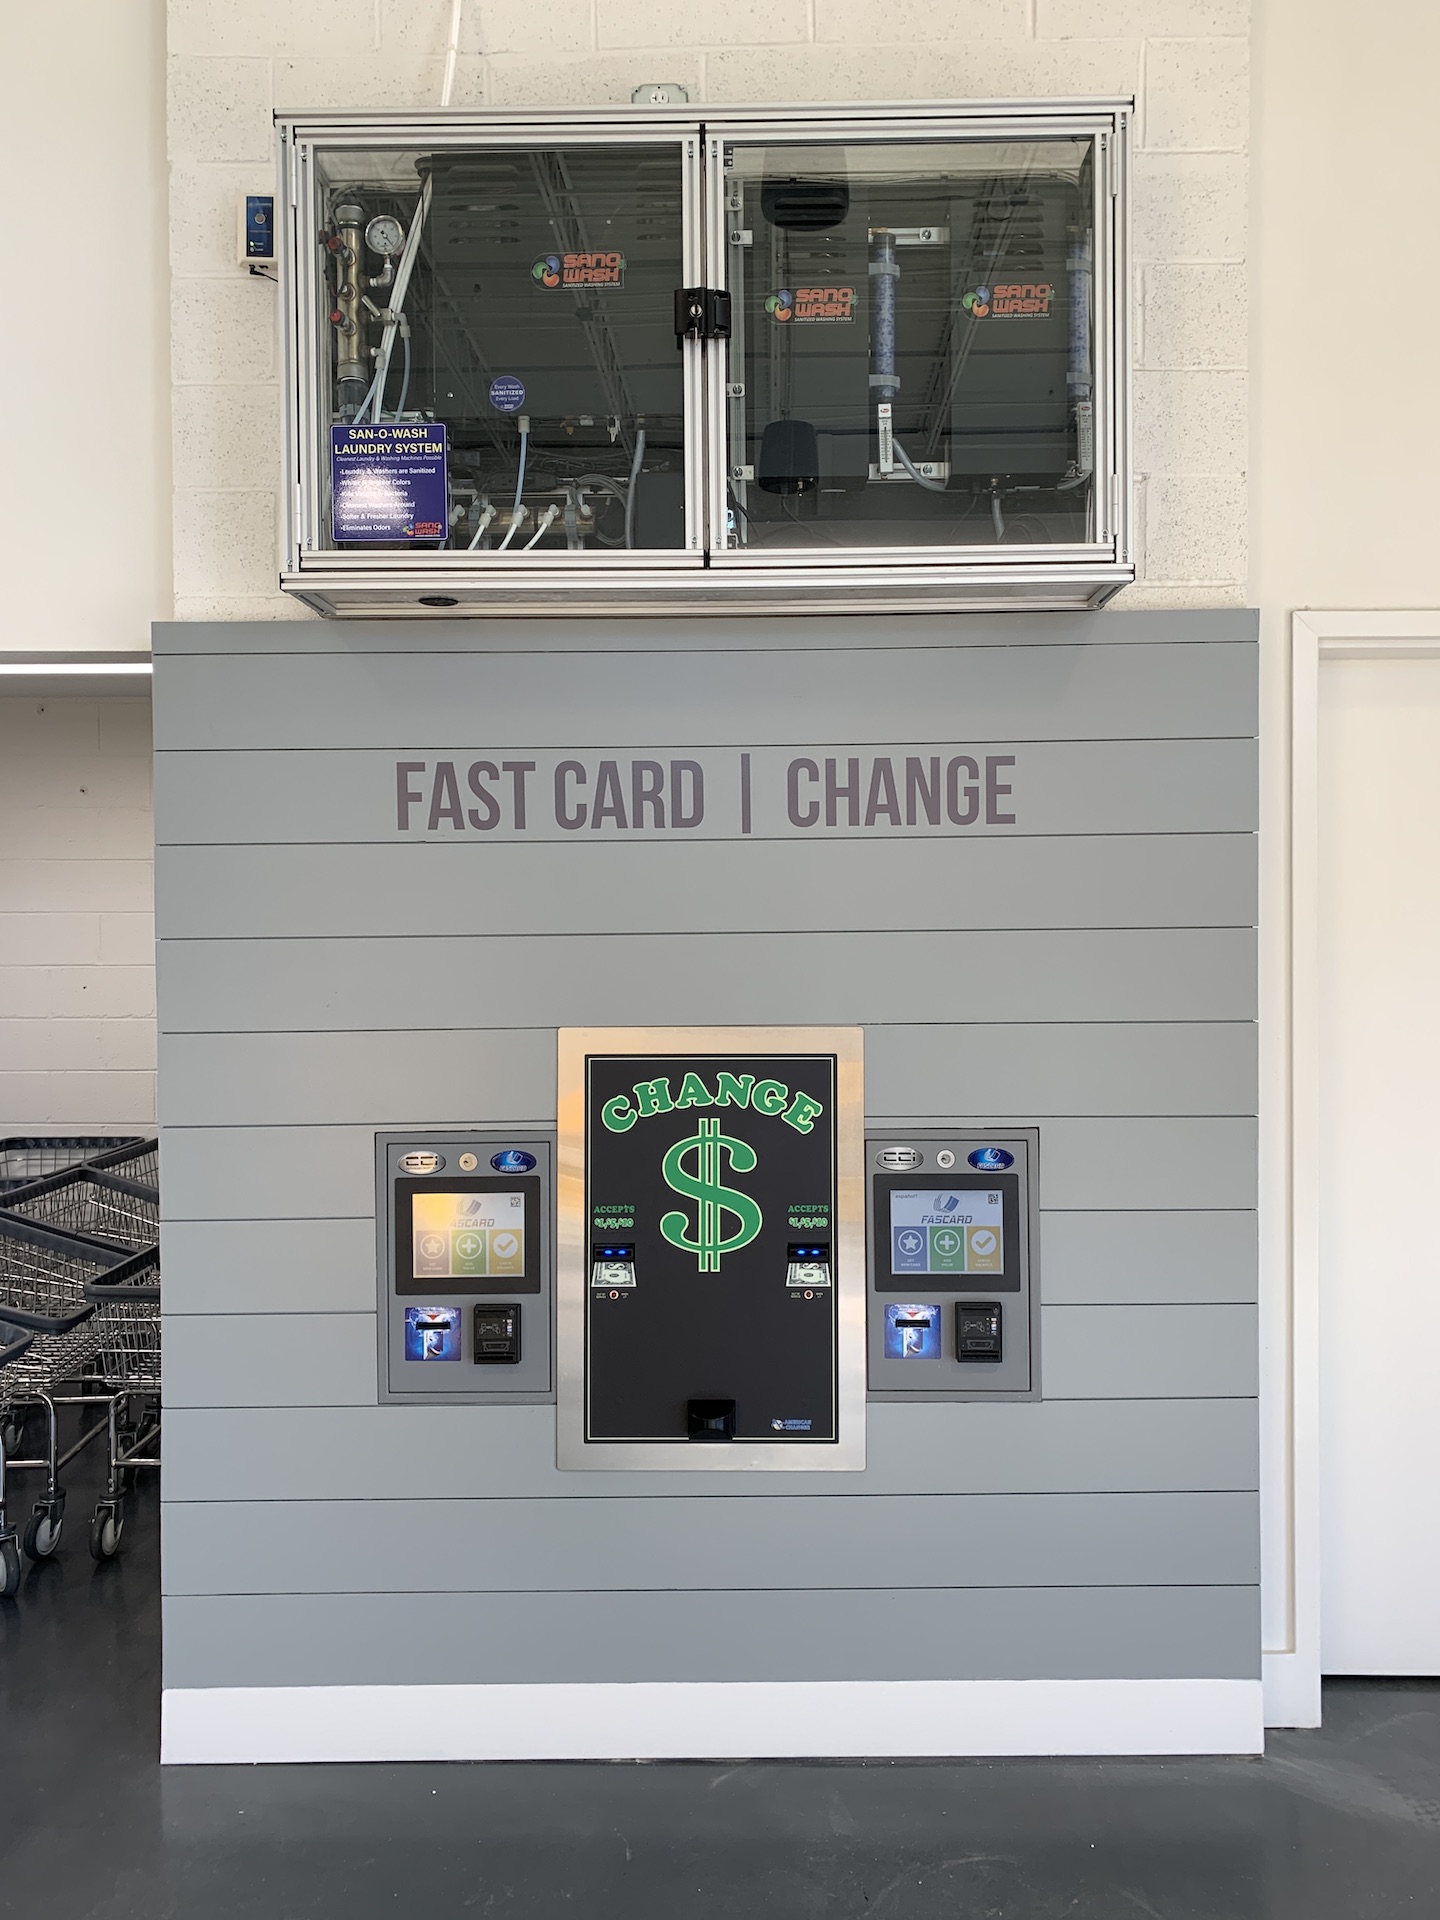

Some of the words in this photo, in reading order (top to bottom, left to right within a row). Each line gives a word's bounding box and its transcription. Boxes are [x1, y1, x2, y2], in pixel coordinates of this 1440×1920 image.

[563, 268, 619, 283] WASH
[795, 303, 851, 317] WASH
[993, 300, 1049, 314] WASH
[349, 428, 427, 439] SAN-O-WASH
[335, 443, 392, 454] LAUNDRY
[395, 442, 442, 453] SYSTEM
[409, 466, 436, 474] Sanitized
[373, 523, 391, 531] Odors
[396, 761, 536, 831] FAST
[554, 759, 704, 829] CARD
[786, 755, 1017, 828] CHANGE
[601, 1072, 823, 1134] CHANGE
[594, 1205, 635, 1214] ACCEPTS
[788, 1205, 829, 1213] ACCEPTS
[921, 1215, 973, 1224] FASCARD
